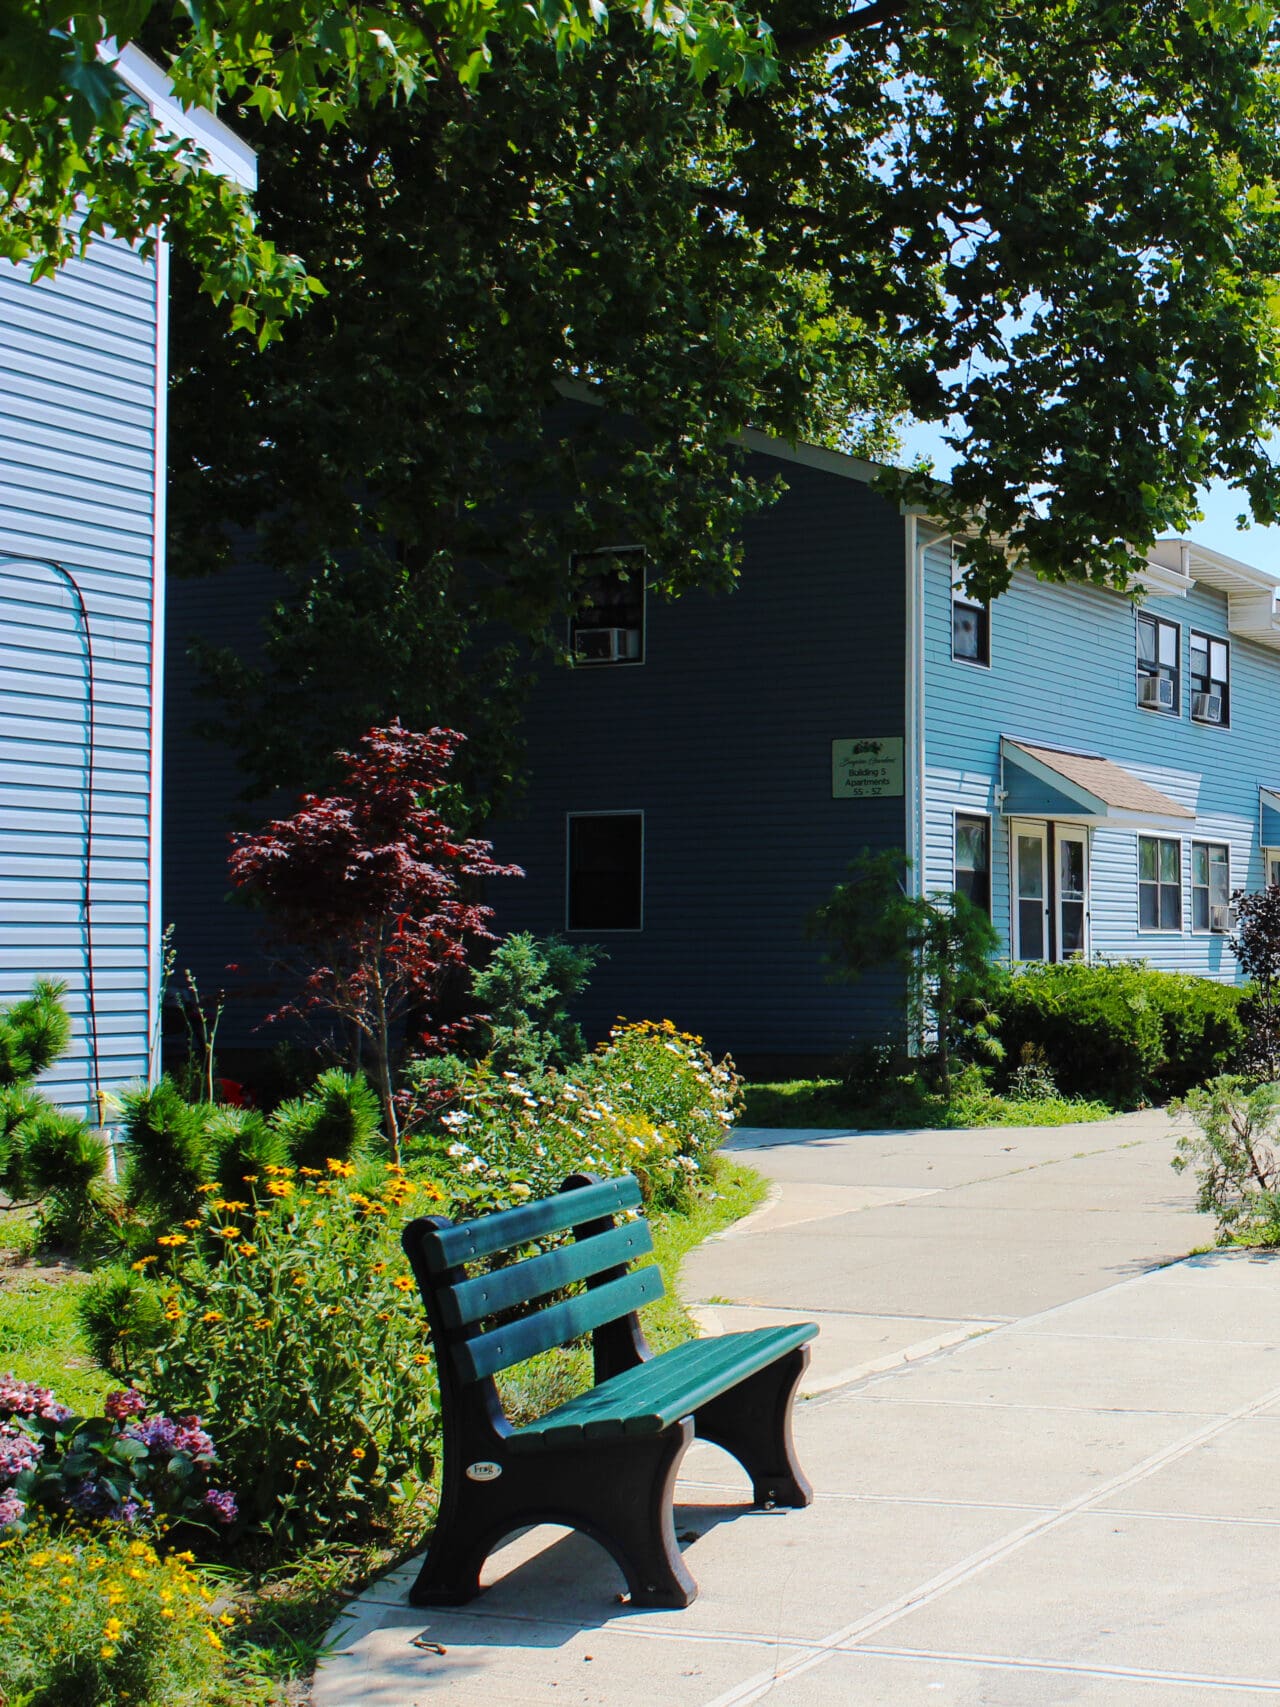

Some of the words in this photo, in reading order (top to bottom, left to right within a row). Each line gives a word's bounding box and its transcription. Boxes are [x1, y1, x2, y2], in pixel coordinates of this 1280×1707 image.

[848, 768, 879, 777] Building
[880, 768, 887, 776] 5
[845, 778, 890, 787] Apartments
